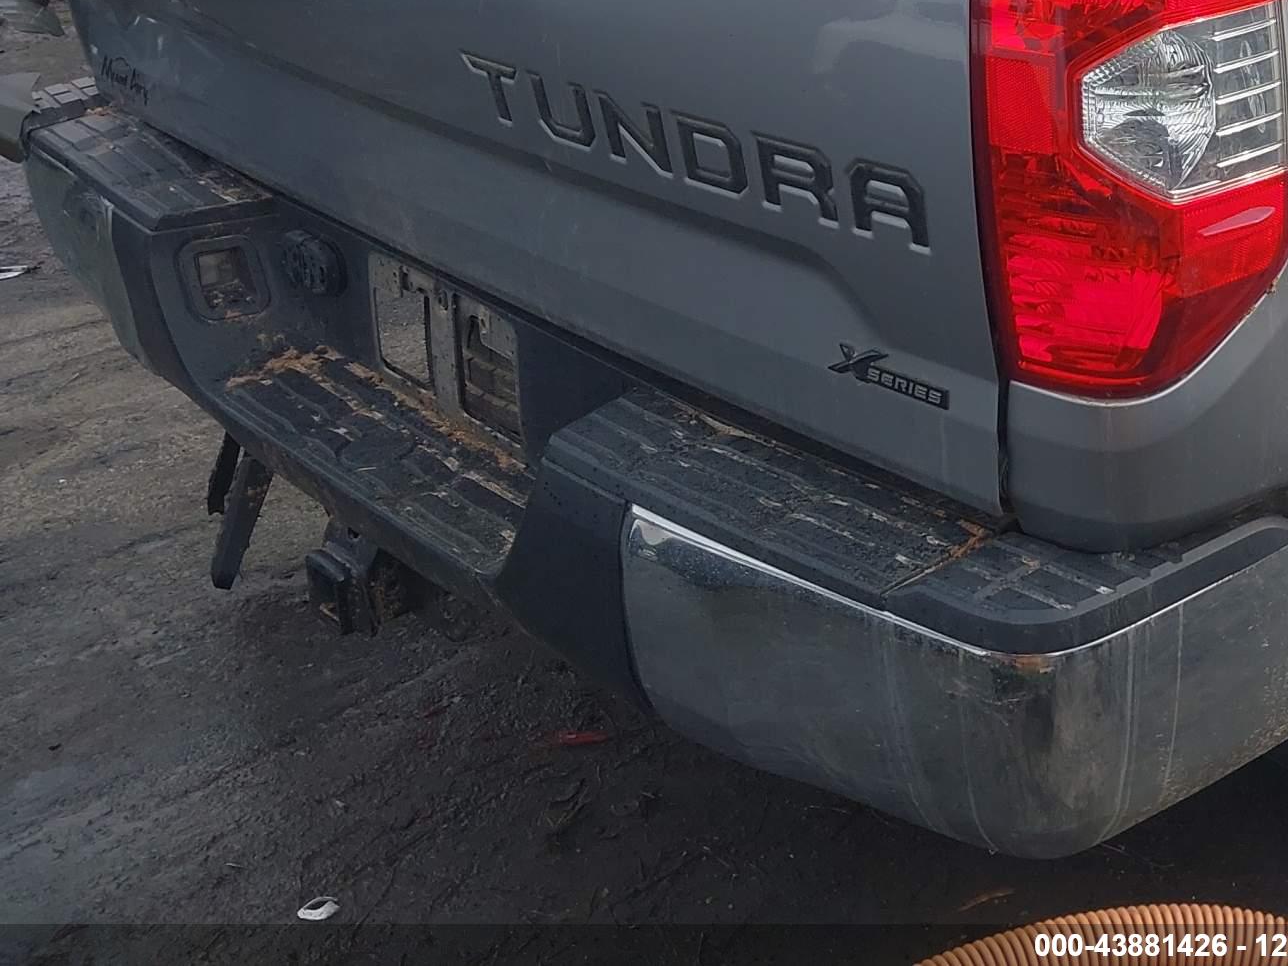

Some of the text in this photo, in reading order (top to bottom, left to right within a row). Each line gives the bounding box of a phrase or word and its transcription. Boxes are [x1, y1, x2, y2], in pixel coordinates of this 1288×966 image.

[460, 48, 931, 256] TUNDRA
[828, 342, 943, 405] X SERIES
